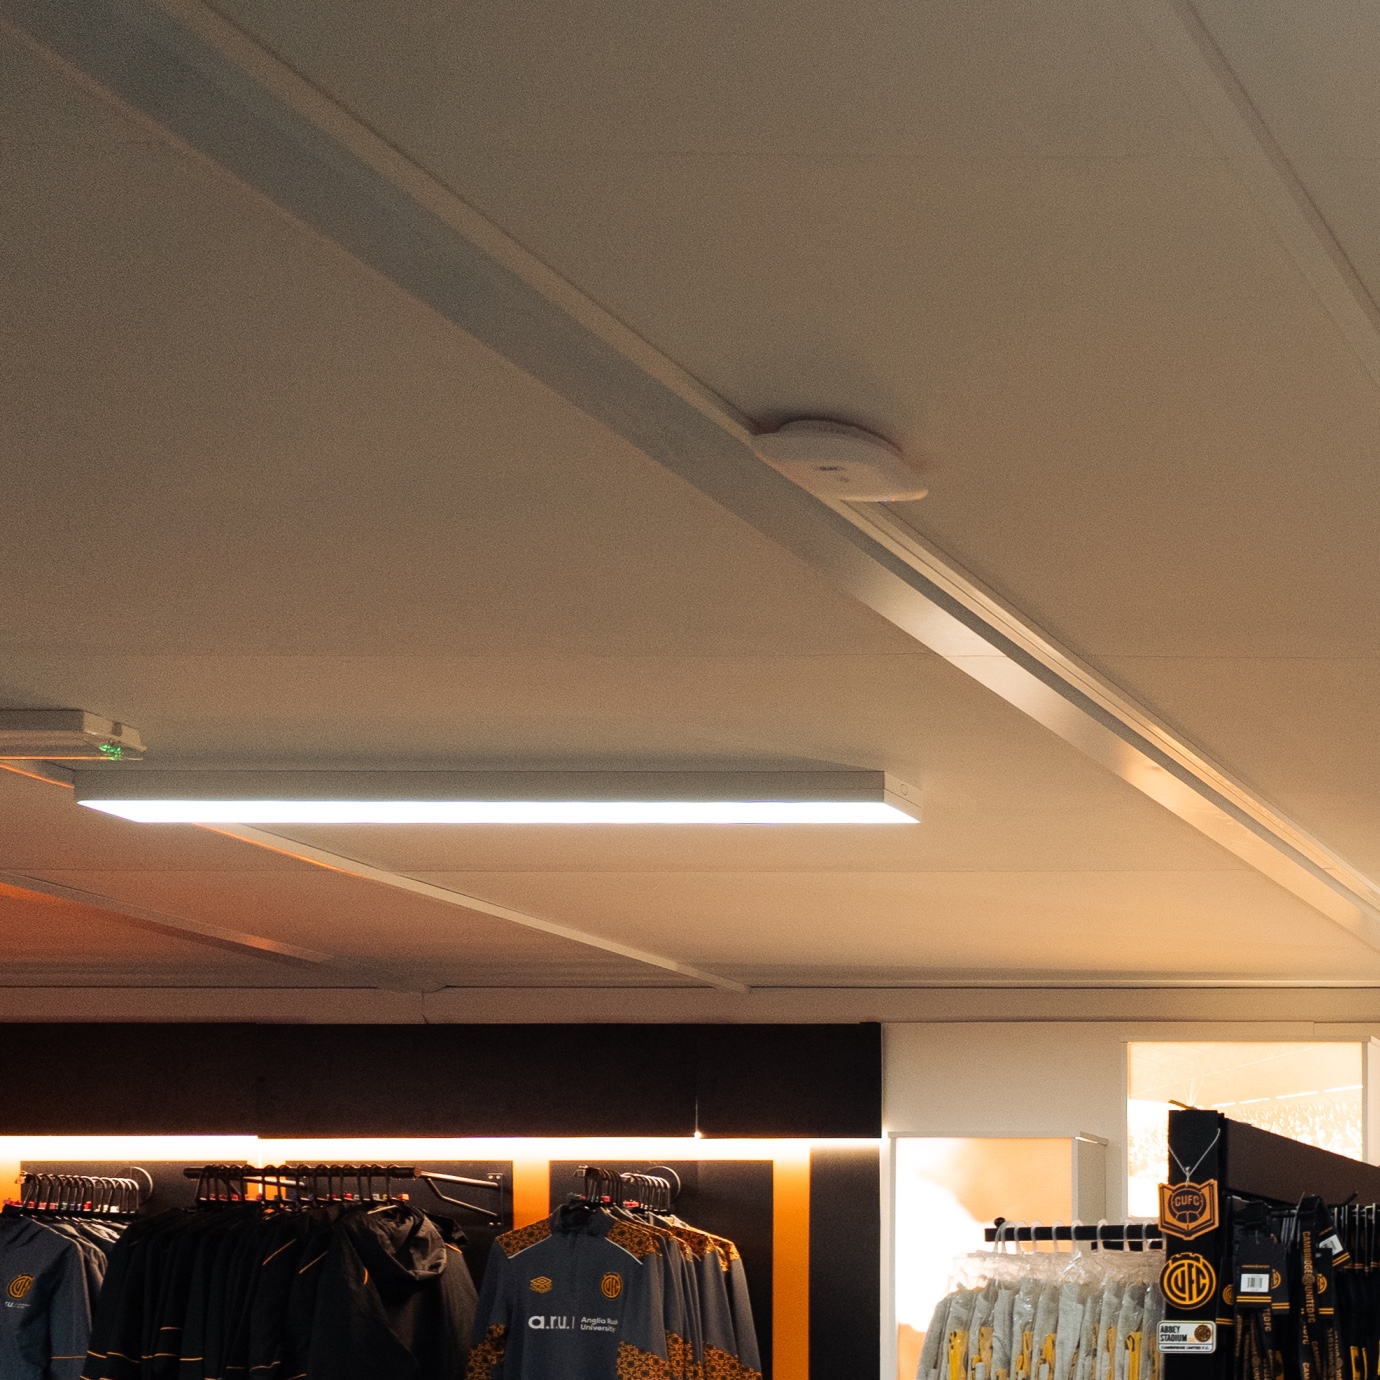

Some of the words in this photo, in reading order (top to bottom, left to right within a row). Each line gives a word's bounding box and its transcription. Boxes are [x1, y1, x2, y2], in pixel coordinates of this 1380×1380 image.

[1174, 1194, 1200, 1207] CUFC
[1302, 1231, 1314, 1274] CAMBRIDGE
[527, 1315, 570, 1330] a.r.u.
[580, 1316, 605, 1325] Anglia
[580, 1324, 616, 1333] University
[1160, 1325, 1180, 1333] ABBEY
[1160, 1334, 1187, 1342] STADIUM
